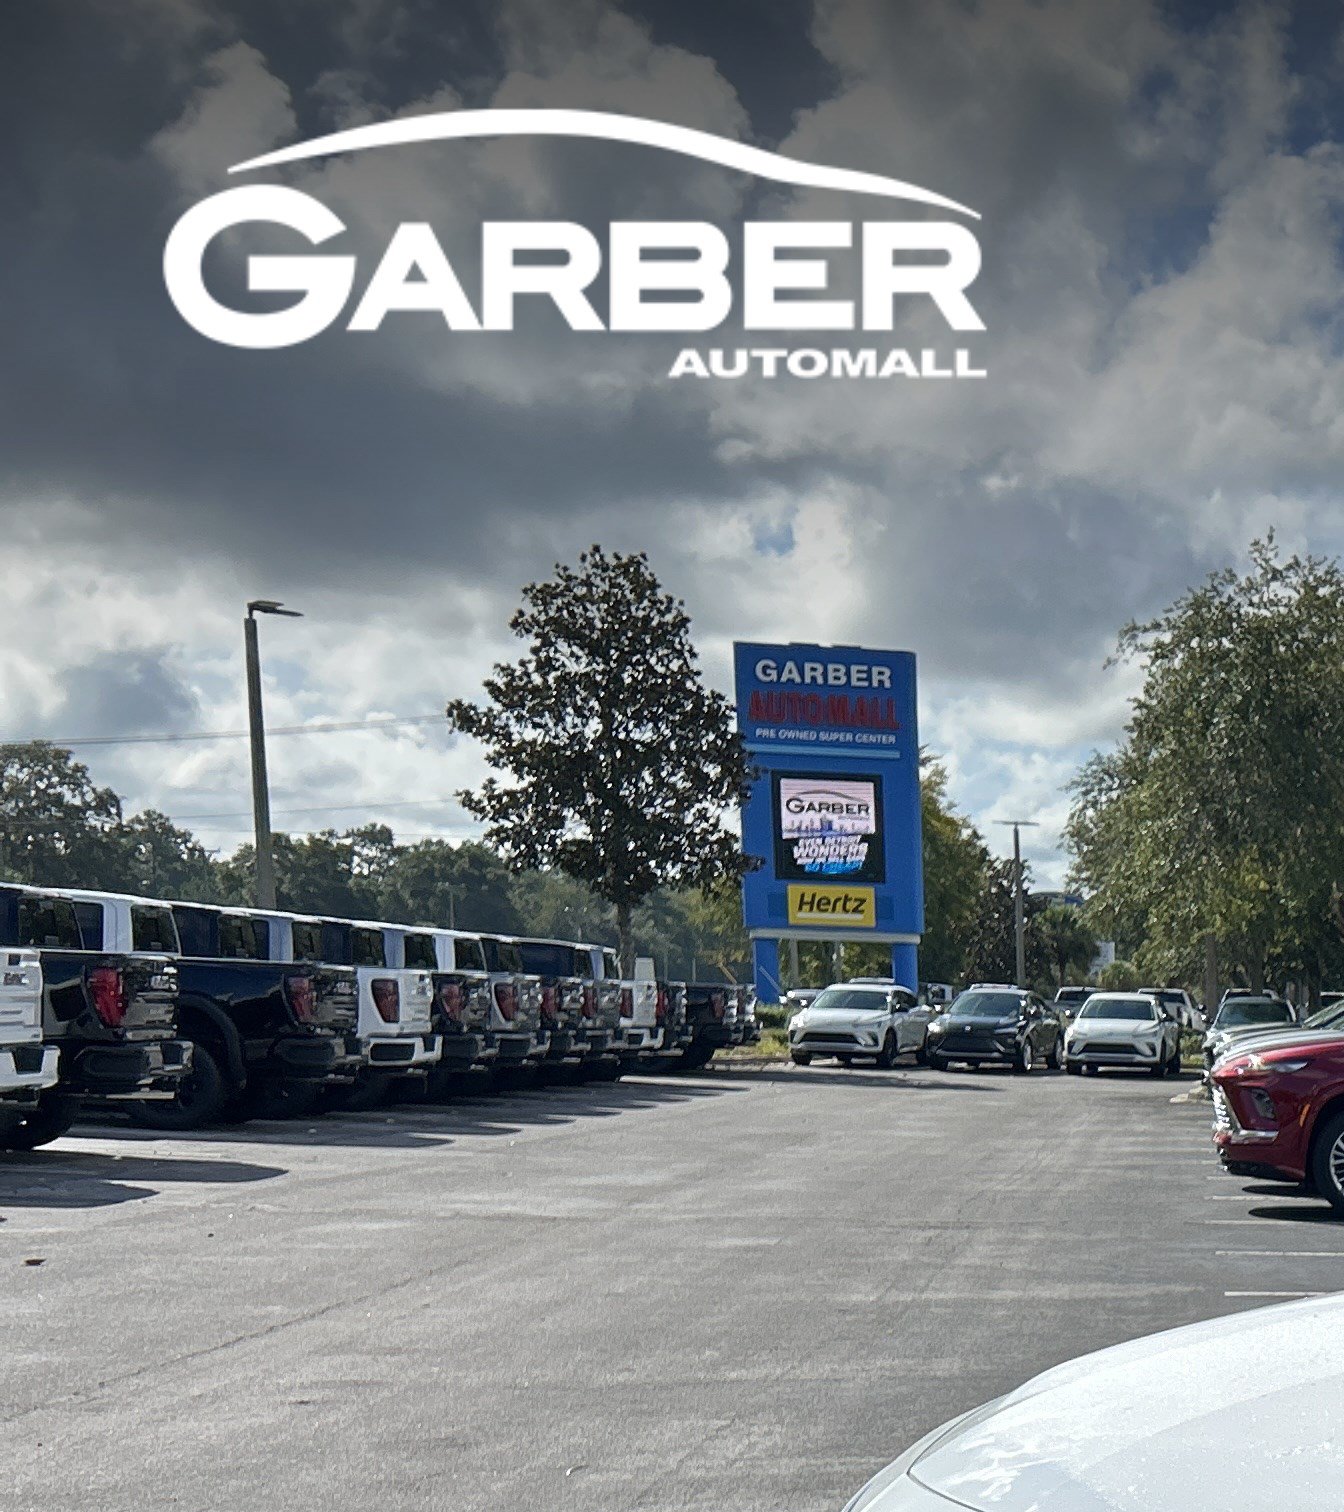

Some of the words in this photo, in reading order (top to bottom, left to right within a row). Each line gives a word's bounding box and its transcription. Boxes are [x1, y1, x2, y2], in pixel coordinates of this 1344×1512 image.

[755, 658, 891, 689] GARBER
[756, 727, 776, 739] PRE
[778, 729, 817, 741] OWNED
[818, 731, 853, 743] SUPER
[855, 733, 896, 745] CENTER
[785, 797, 870, 815] GARBER
[798, 892, 867, 914] Hertz
